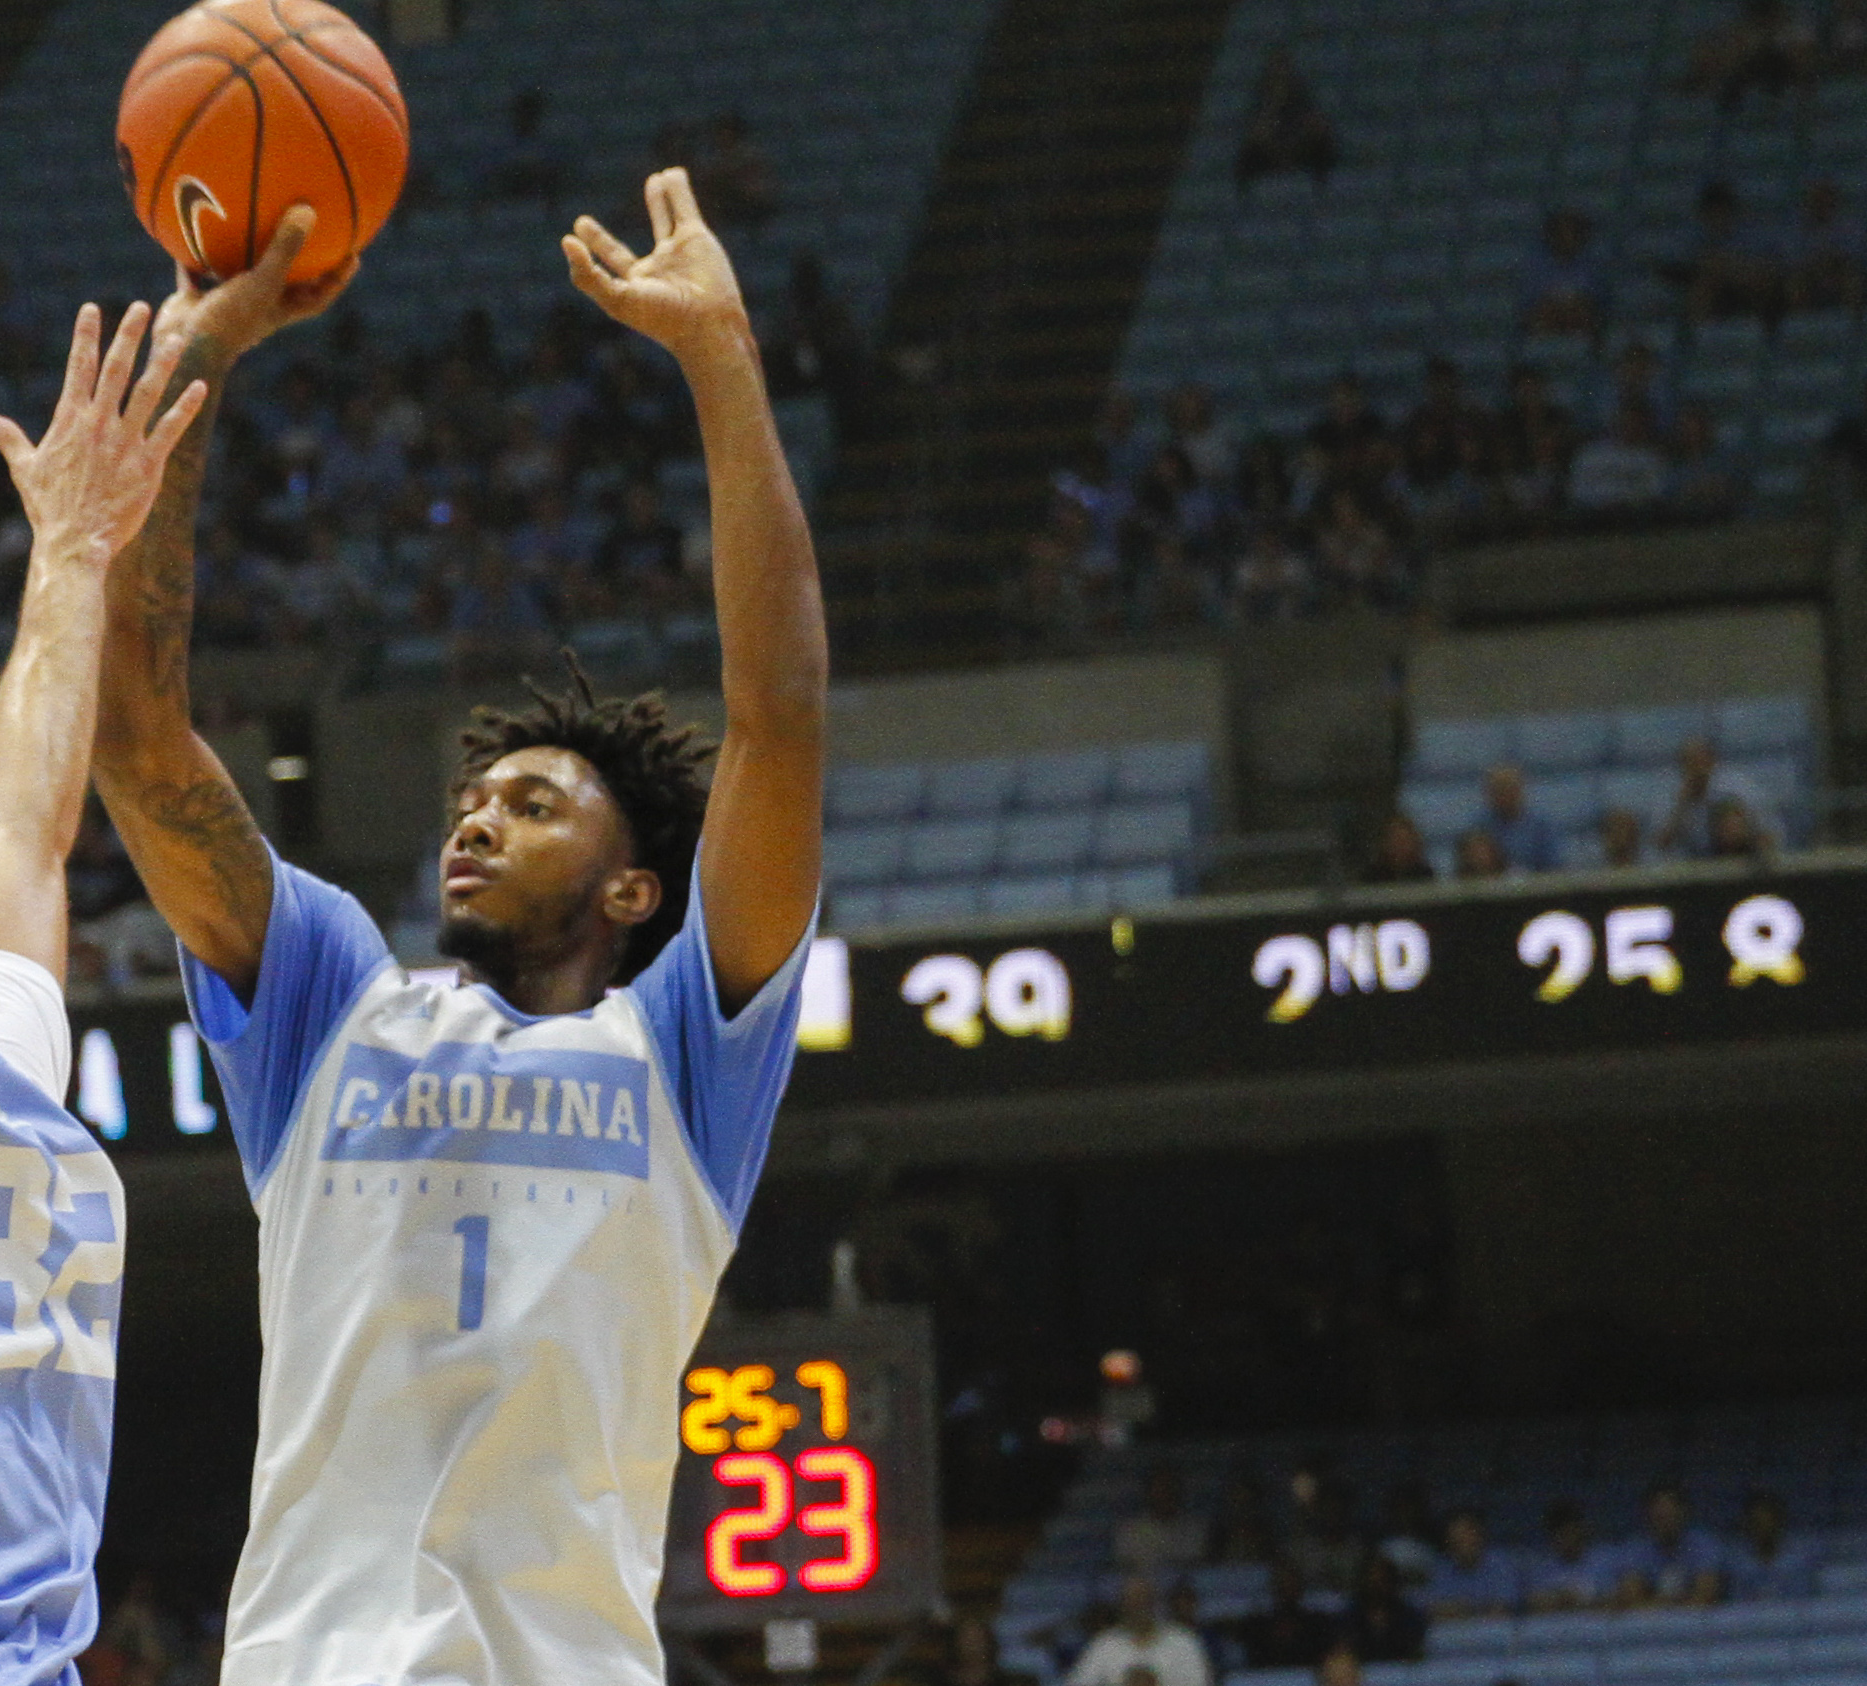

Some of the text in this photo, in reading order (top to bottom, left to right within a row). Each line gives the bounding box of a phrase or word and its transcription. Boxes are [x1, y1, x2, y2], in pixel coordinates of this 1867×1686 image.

[1250, 918, 1431, 1024] 2ND
[453, 1214, 490, 1332] 1
[704, 1445, 881, 1598] 23
